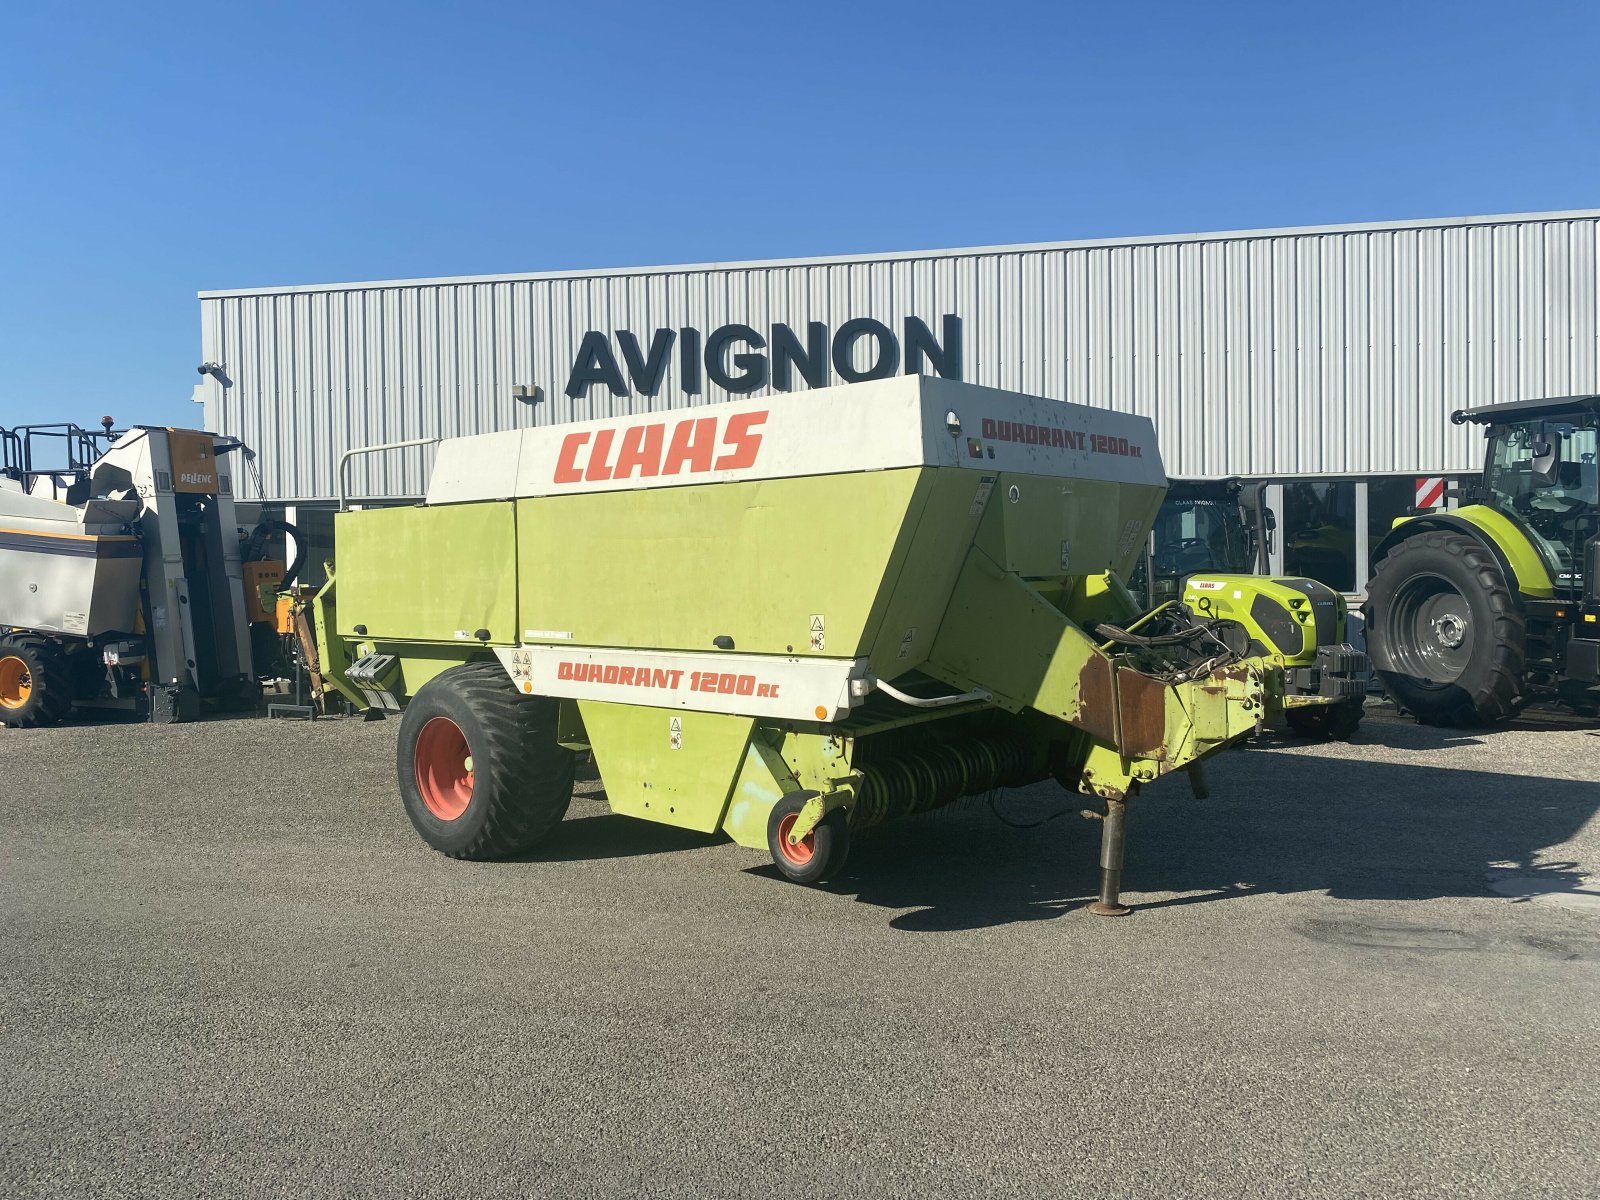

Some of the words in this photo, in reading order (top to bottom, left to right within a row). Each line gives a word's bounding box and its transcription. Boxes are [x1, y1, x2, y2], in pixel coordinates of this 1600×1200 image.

[565, 314, 962, 398] AVIGNON
[553, 410, 769, 484] CLAAS
[982, 418, 1086, 450] QUADRANT
[1090, 434, 1129, 456] 1200
[181, 472, 212, 484] PELLENC
[557, 662, 684, 690] QUADRANT
[690, 671, 757, 696] 1200
[757, 682, 780, 699] RC
